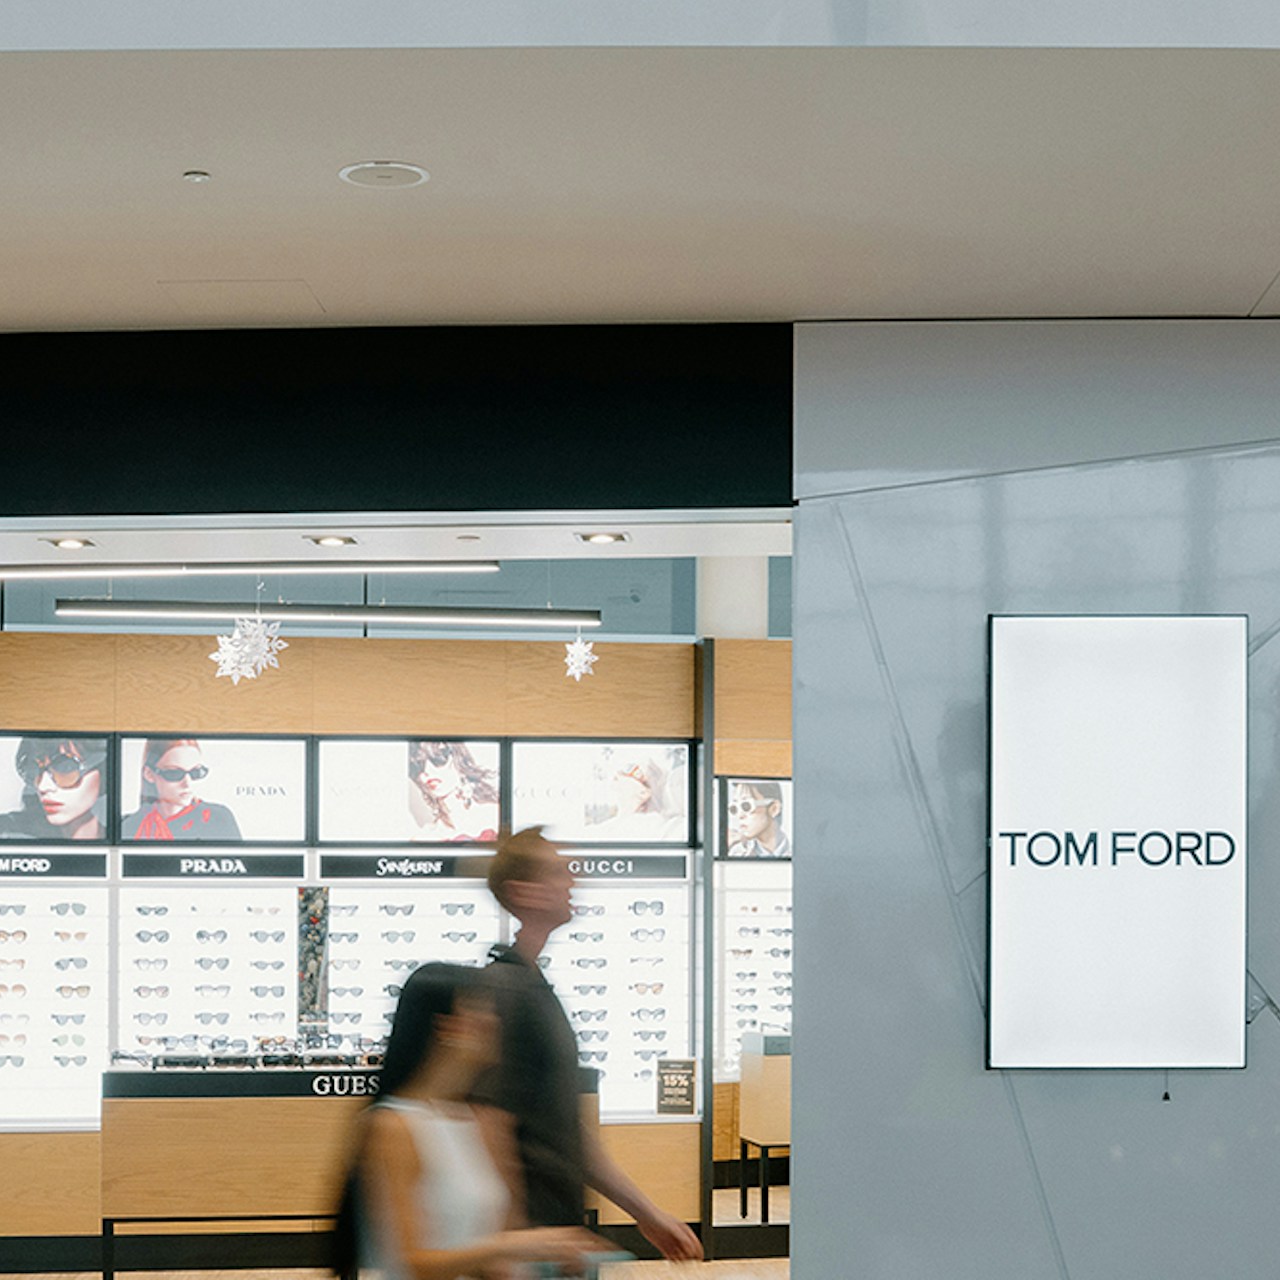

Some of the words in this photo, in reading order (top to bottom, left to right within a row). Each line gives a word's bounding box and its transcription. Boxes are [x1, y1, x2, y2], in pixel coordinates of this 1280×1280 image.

[235, 786, 287, 797] PRADA
[999, 832, 1097, 866] TOM
[1111, 831, 1237, 867] FORD
[11, 858, 51, 872] FORD
[180, 859, 247, 873] PRADA
[568, 859, 633, 873] GUCCI
[312, 1075, 380, 1095] GUES
